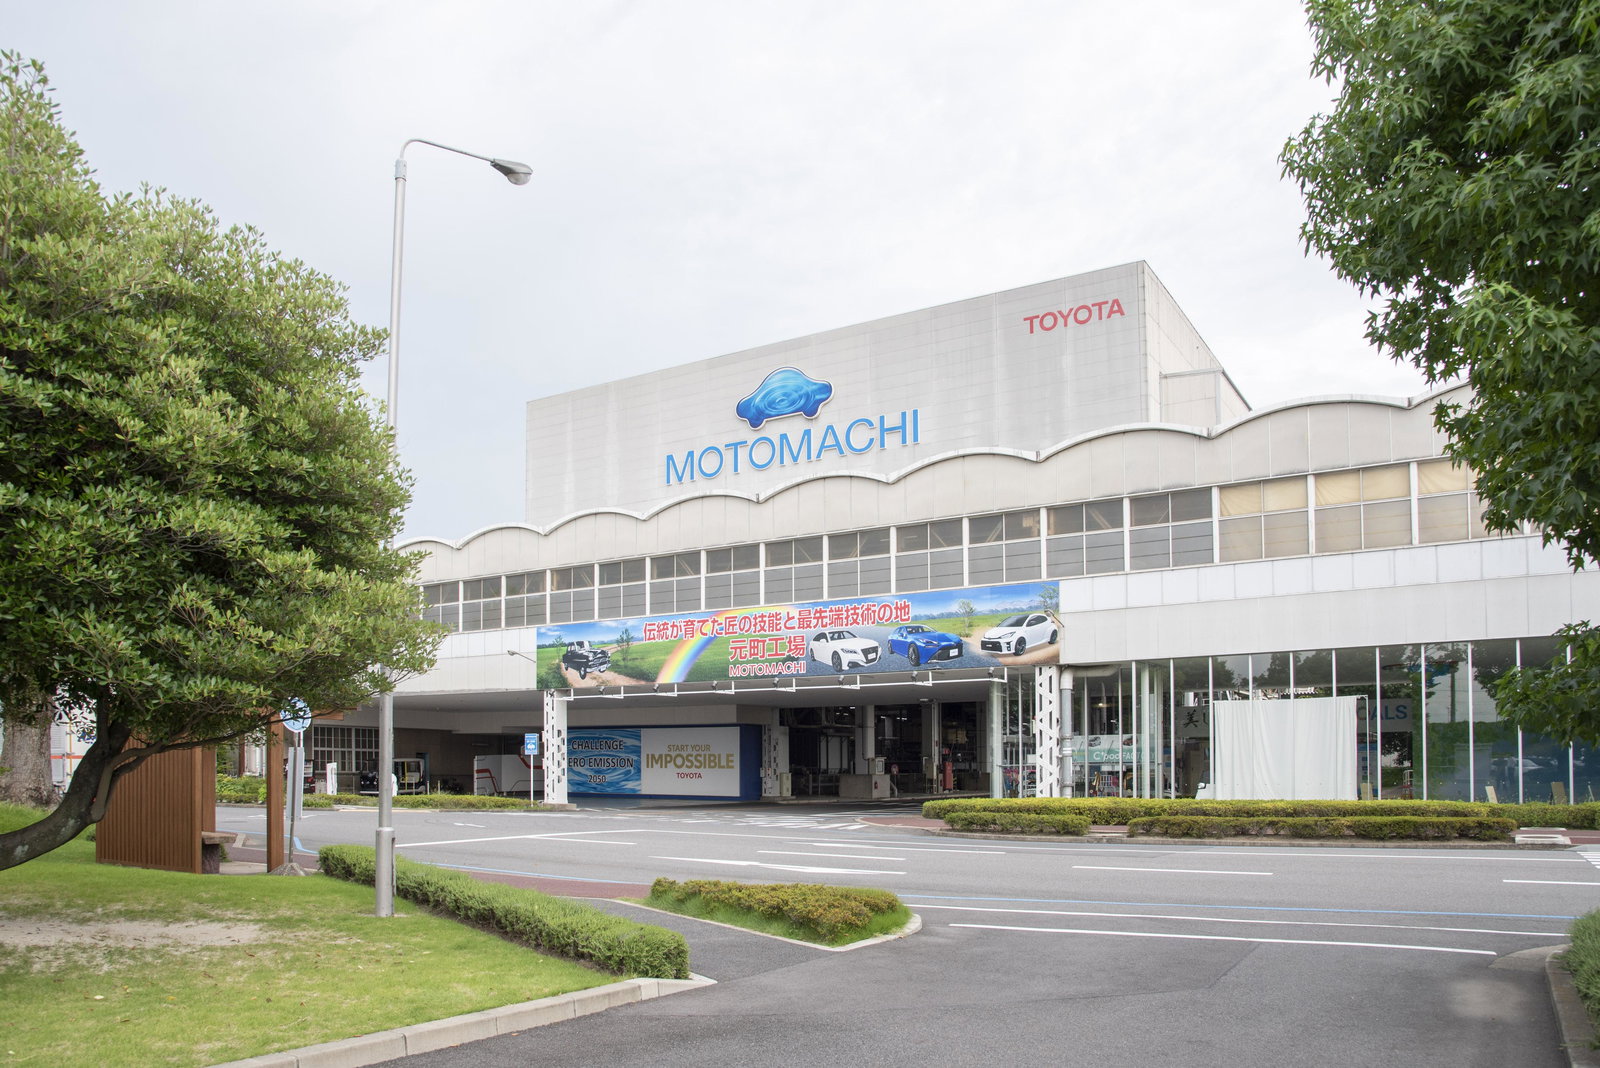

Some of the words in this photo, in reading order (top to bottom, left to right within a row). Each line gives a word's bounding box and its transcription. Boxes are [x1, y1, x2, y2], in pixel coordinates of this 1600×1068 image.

[1024, 298, 1126, 335] TOYOTA
[665, 408, 921, 485] MOTOMACHI
[643, 600, 911, 642] 伝統が育てた匠の技能と最先端技術の地
[729, 635, 805, 660] 元町工場
[729, 661, 806, 677] MOTOMACHI
[1357, 704, 1408, 720] OALS
[571, 740, 624, 750] CHALLENGE
[667, 744, 689, 752] START
[690, 744, 711, 752] YOUR
[568, 757, 586, 768] ERO
[588, 757, 634, 768] EMISSION
[645, 753, 735, 769] IMPOSSIBLE
[588, 774, 607, 784] 2050
[676, 772, 703, 780] TOYOTA
